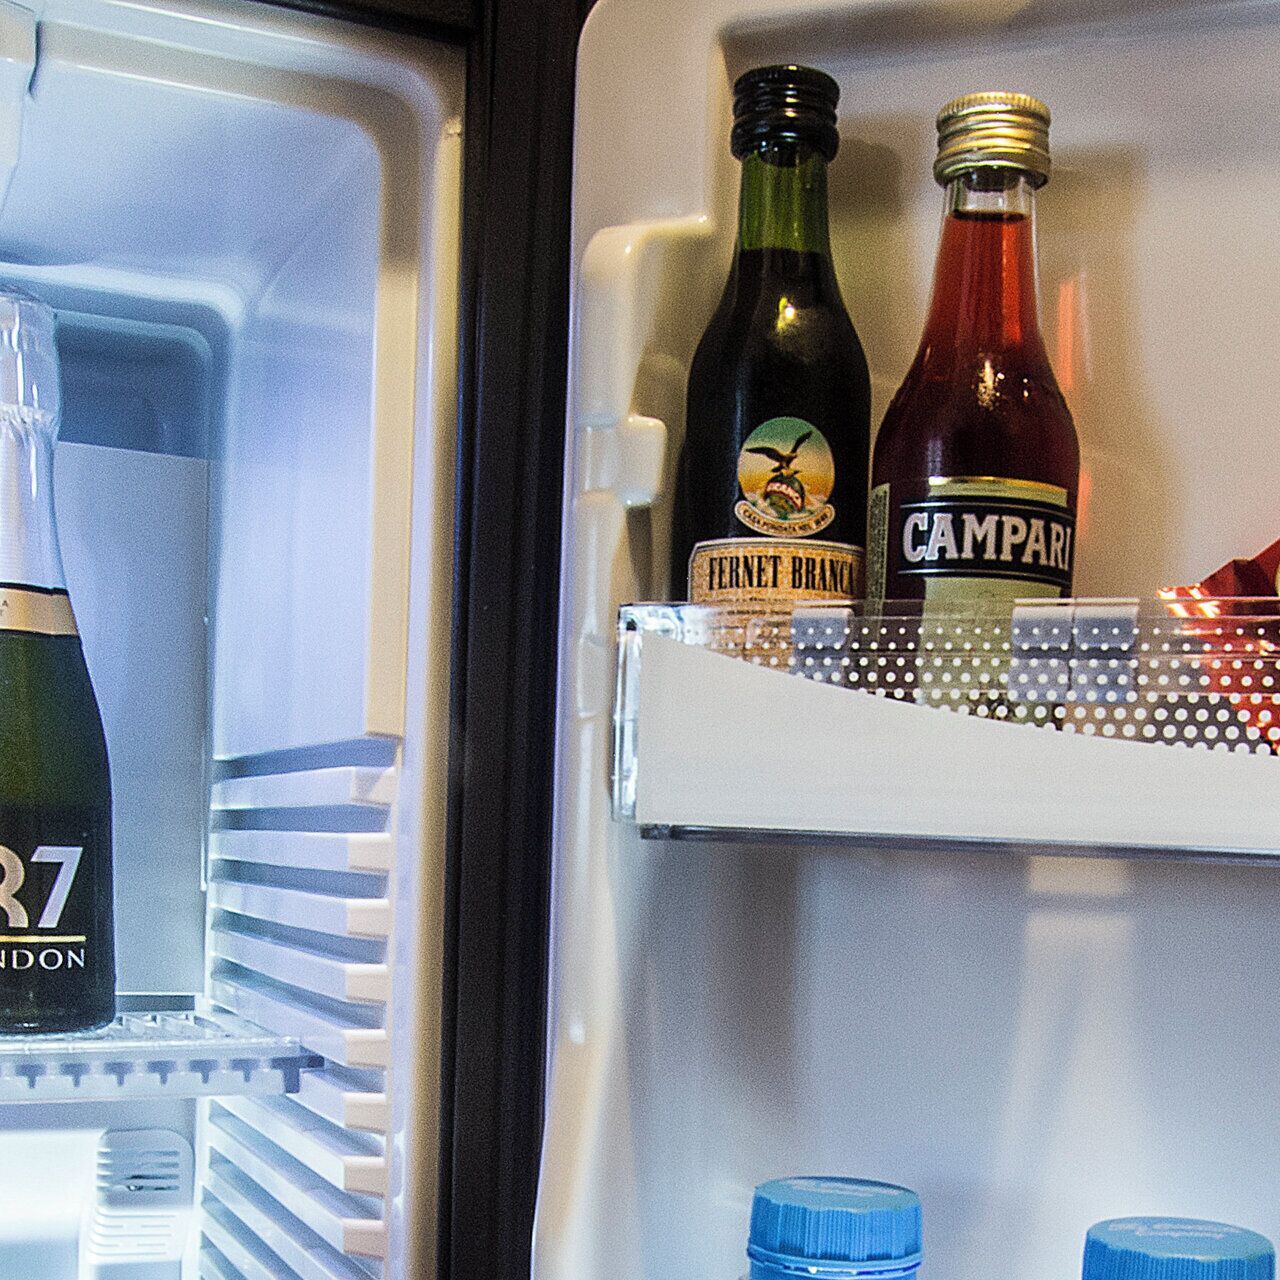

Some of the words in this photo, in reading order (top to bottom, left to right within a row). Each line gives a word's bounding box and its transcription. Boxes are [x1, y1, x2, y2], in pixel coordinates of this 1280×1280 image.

[903, 512, 1070, 571] CAMPARI
[708, 555, 782, 591] FERNET
[791, 555, 856, 595] BRANCA
